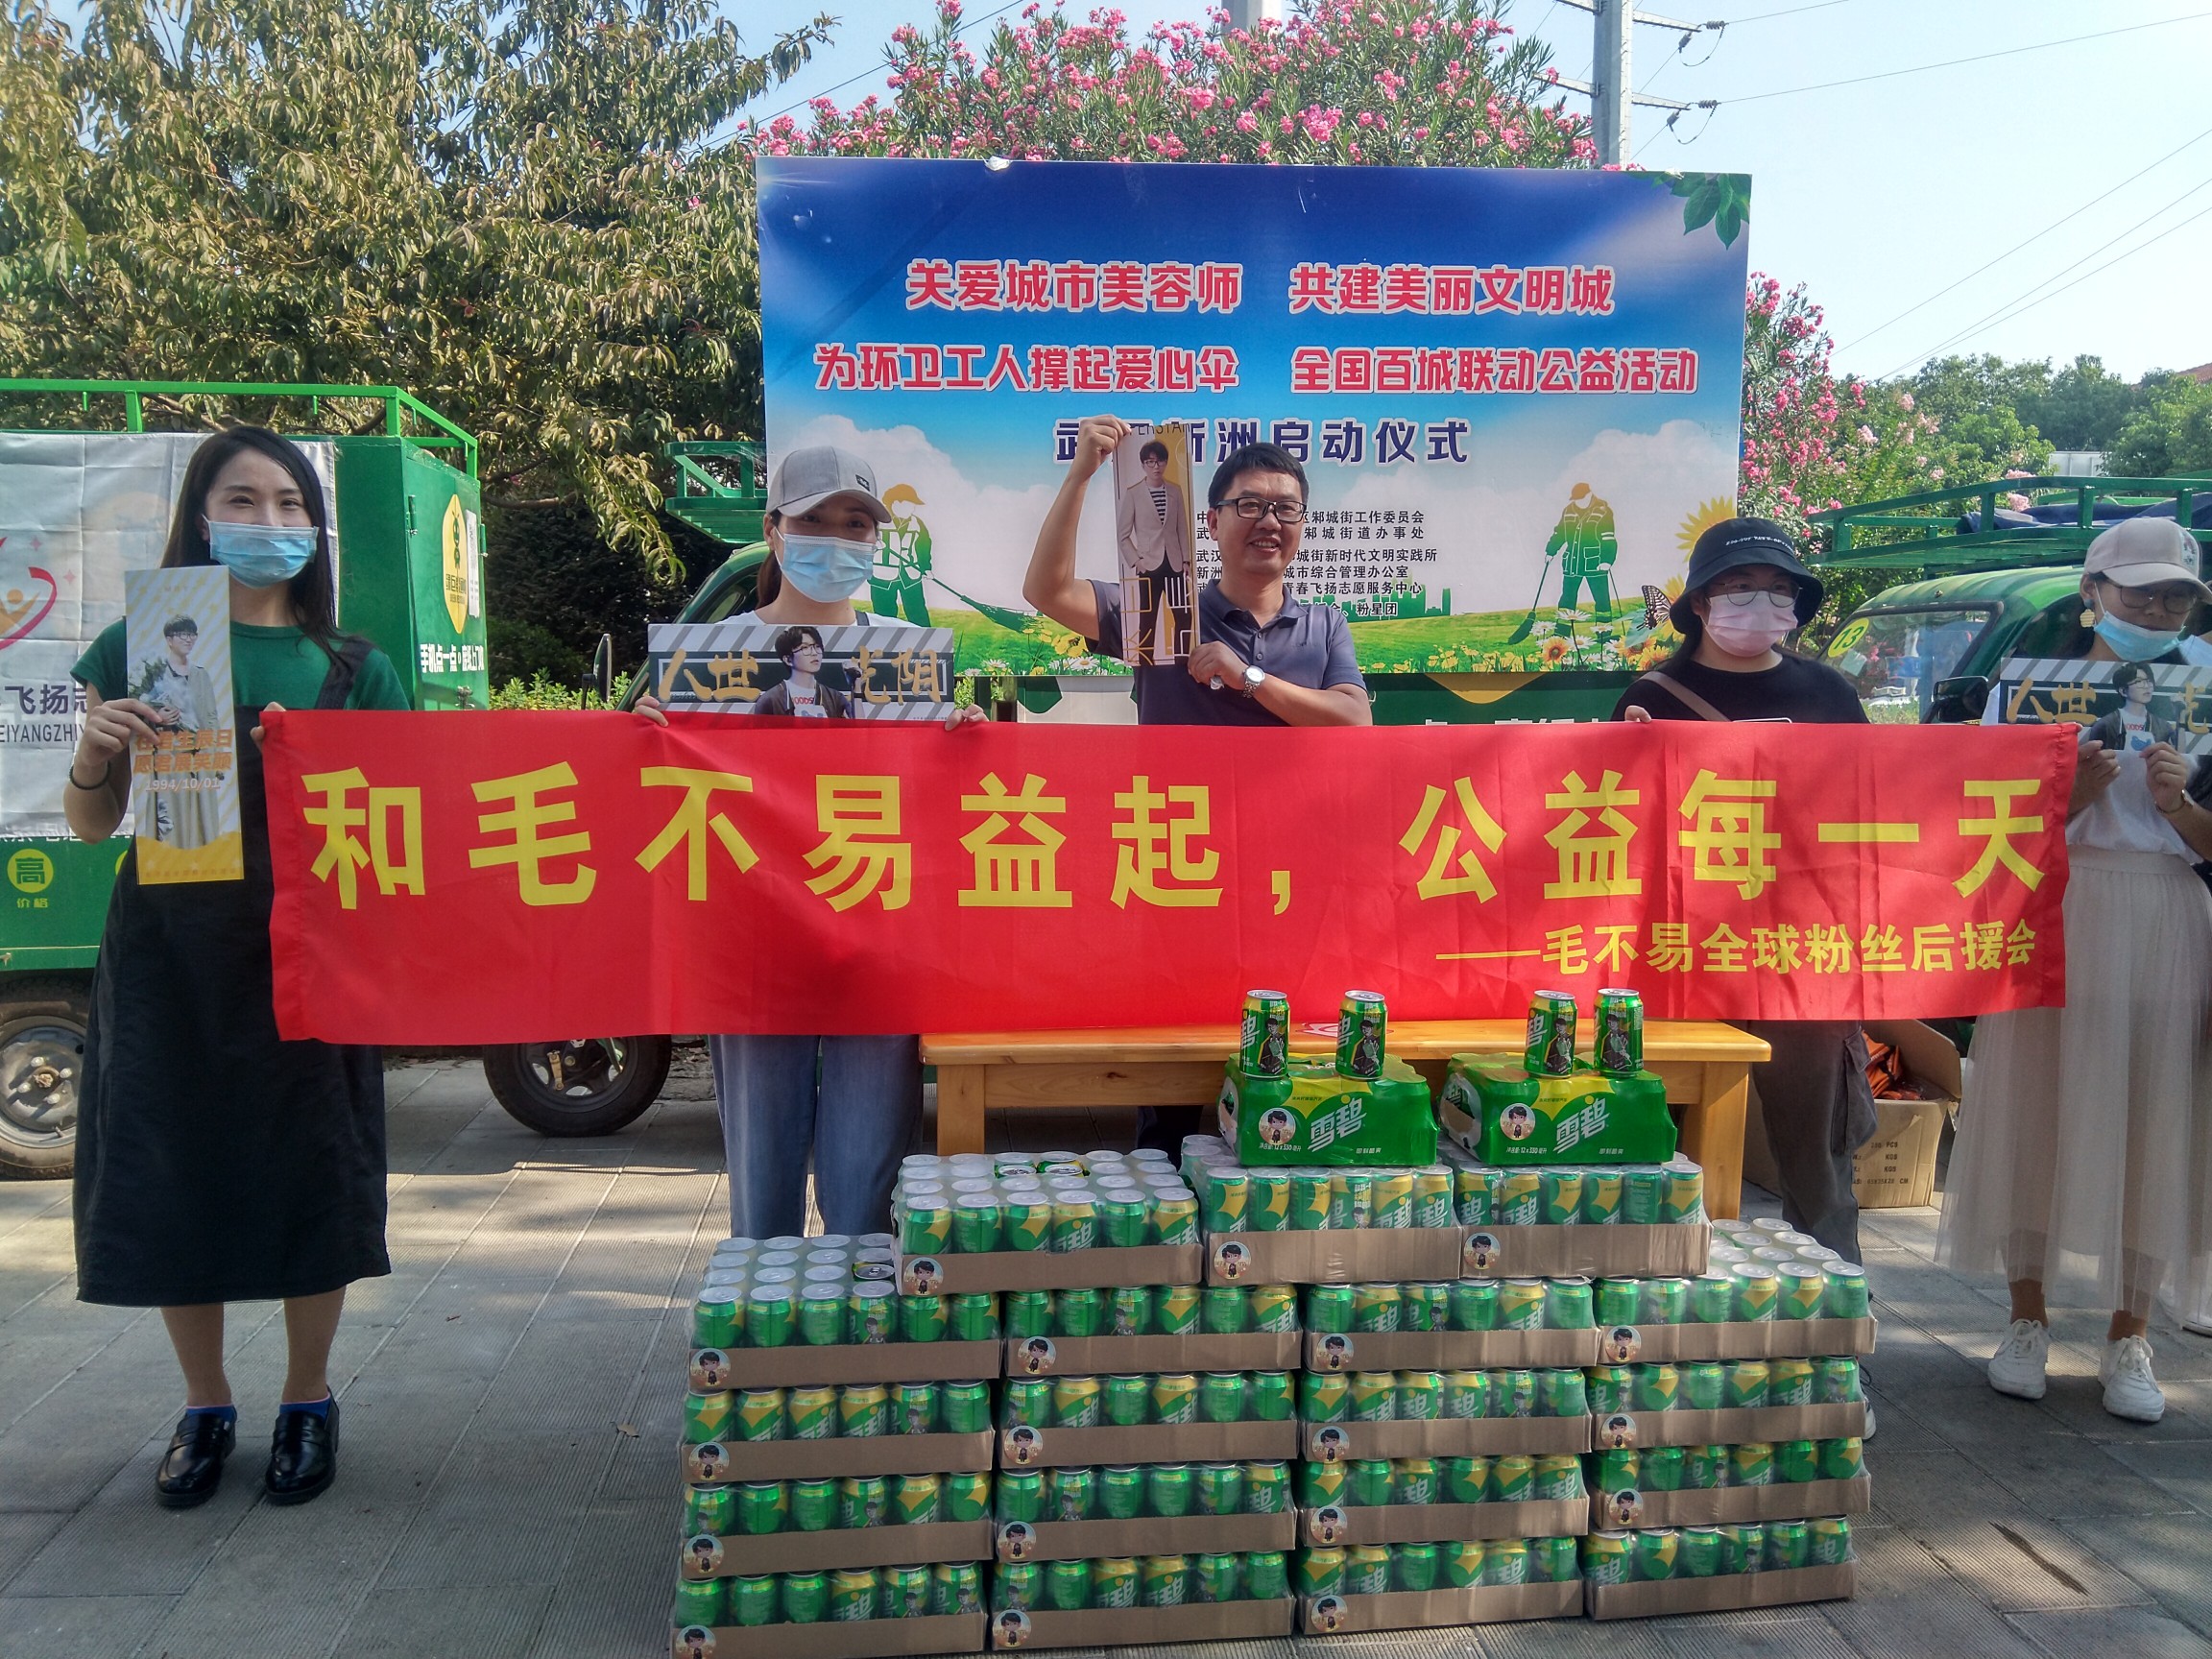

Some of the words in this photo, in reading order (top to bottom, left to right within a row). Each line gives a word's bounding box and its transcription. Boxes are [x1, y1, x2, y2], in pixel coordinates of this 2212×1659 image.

[907, 260, 1241, 312] 关爱城市美容师
[1290, 264, 1614, 314] 共建美丽文明城
[815, 344, 1238, 392] 为环卫工人撑起爱心伞
[1292, 347, 1697, 394] 全国百城联动公益活动
[1834, 626, 1864, 650] 13
[145, 776, 221, 793] 1994/10/01
[15, 856, 45, 884] 高
[16, 898, 48, 908] 价格
[1308, 1097, 1367, 1152] 雪碧
[1553, 1097, 1610, 1153] 雪碧
